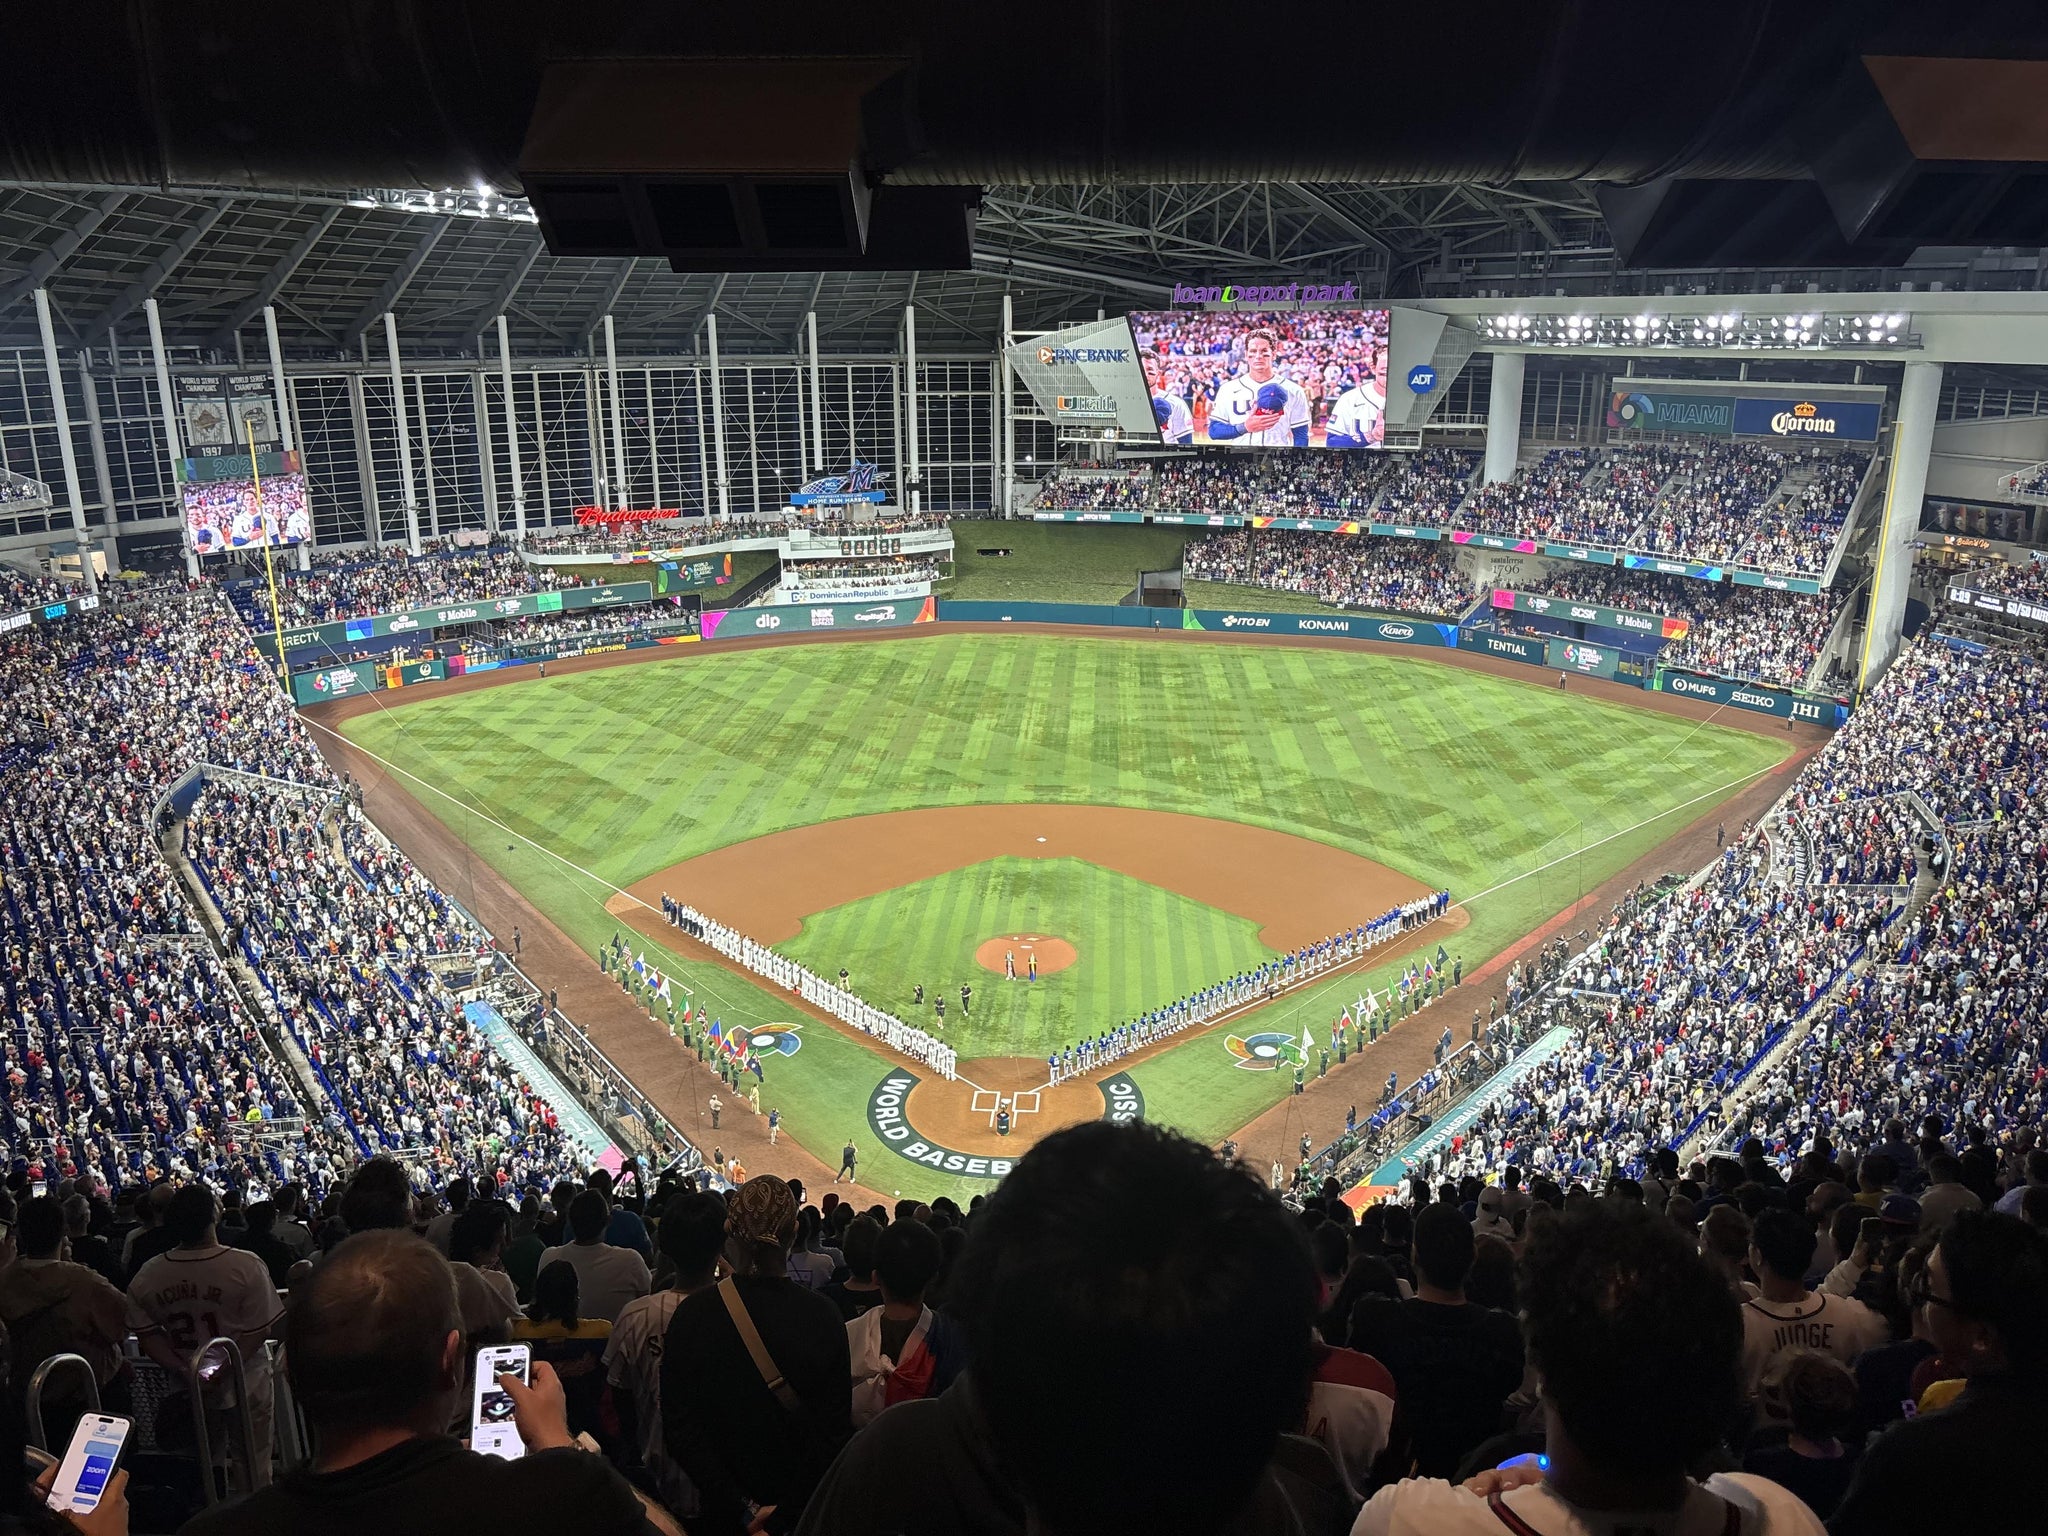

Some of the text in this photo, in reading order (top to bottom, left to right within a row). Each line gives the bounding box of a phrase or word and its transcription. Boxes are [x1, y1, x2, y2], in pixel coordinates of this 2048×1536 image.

[1173, 281, 1358, 306] loanDepot park
[1411, 374, 1433, 385] ADT
[1657, 403, 1729, 426] MIAMI
[1771, 411, 1836, 436] Corona
[201, 447, 222, 457] 1997
[574, 506, 680, 526] Budweiser
[1492, 564, 1520, 577] 1796
[1763, 577, 1788, 589] Google
[592, 596, 623, 604] Budweiser
[447, 608, 477, 621] Mobile
[756, 614, 780, 629] dip
[1237, 617, 1270, 627] ITO EN
[1299, 620, 1349, 632] KONAMI
[1624, 617, 1652, 630] Mobile
[1382, 624, 1411, 637] Kowa
[557, 644, 626, 659] EXPECT EVERYTHING
[1488, 639, 1527, 656] TENTIAL
[1688, 682, 1716, 696] MUFG
[1731, 691, 1775, 708] SEIKO
[1792, 701, 1820, 718] IHI
[875, 1078, 1138, 1175] WORLD BASEB SSIC
[1414, 1082, 1511, 1159] WORLD BASEBALL CLASSIC
[167, 1312, 220, 1351] 21
[86, 1466, 106, 1475] zoom
